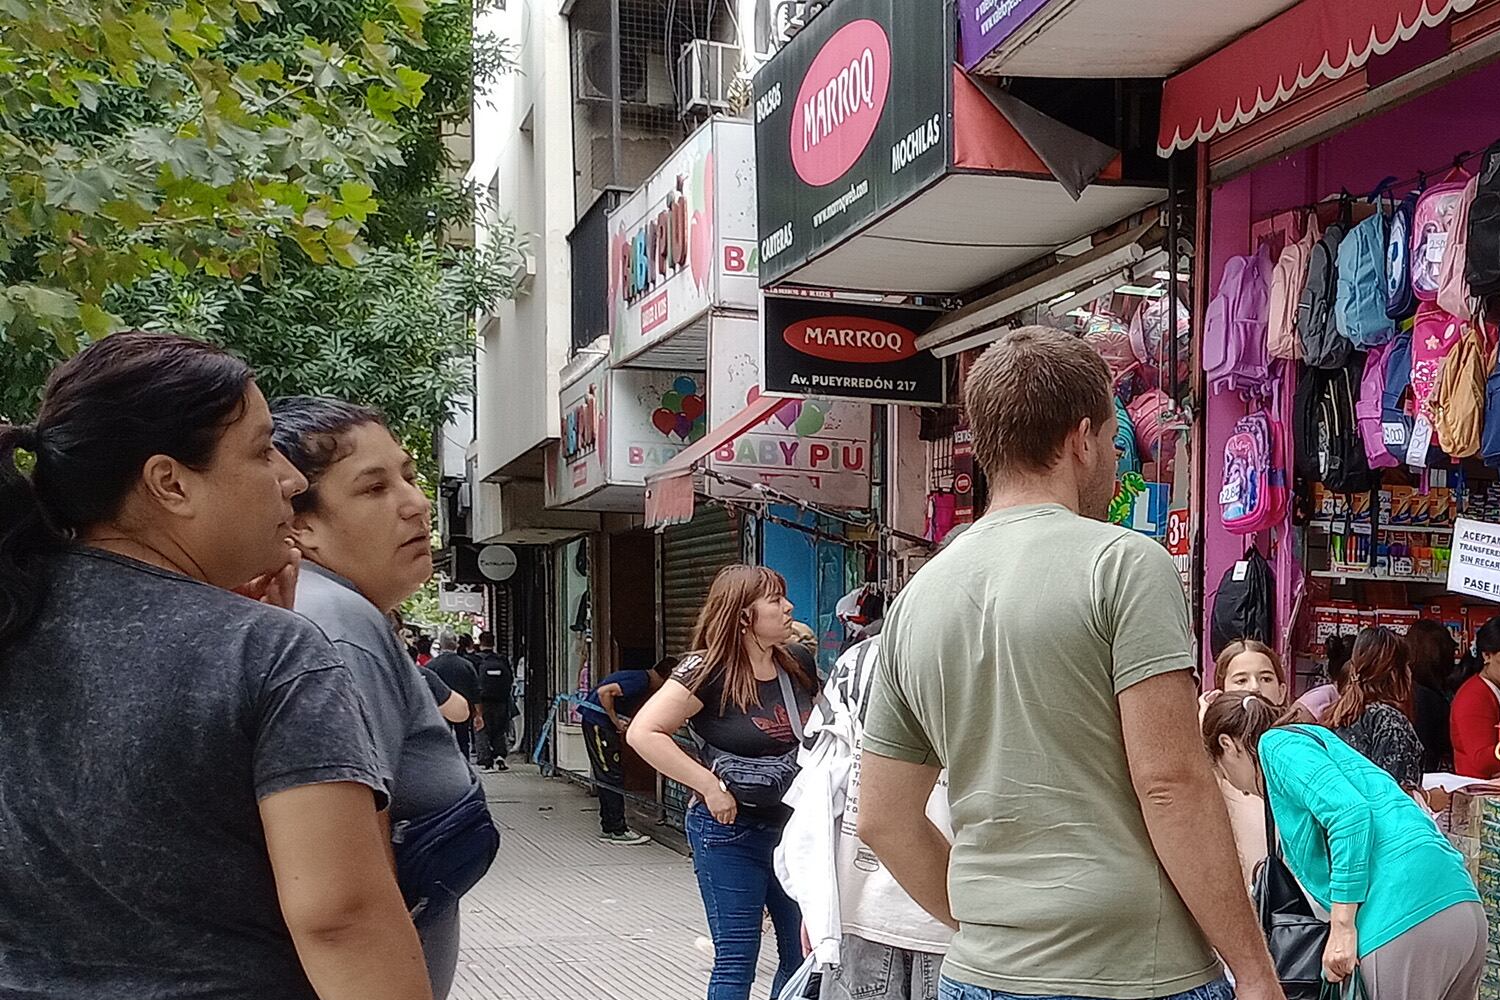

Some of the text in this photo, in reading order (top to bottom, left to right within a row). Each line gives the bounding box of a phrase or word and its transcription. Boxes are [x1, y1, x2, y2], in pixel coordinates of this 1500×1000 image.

[756, 82, 782, 124] BOLSOS
[803, 48, 875, 152] MARROQ
[892, 114, 940, 174] MOCHILAS
[761, 222, 794, 263] CARTERAS
[805, 327, 902, 352] MARROQ
[790, 374, 917, 391] Av. PUEYRREDÓN 217
[714, 440, 799, 465] BABY
[1460, 554, 1472, 565] SIN
[1463, 577, 1489, 593] PASE
